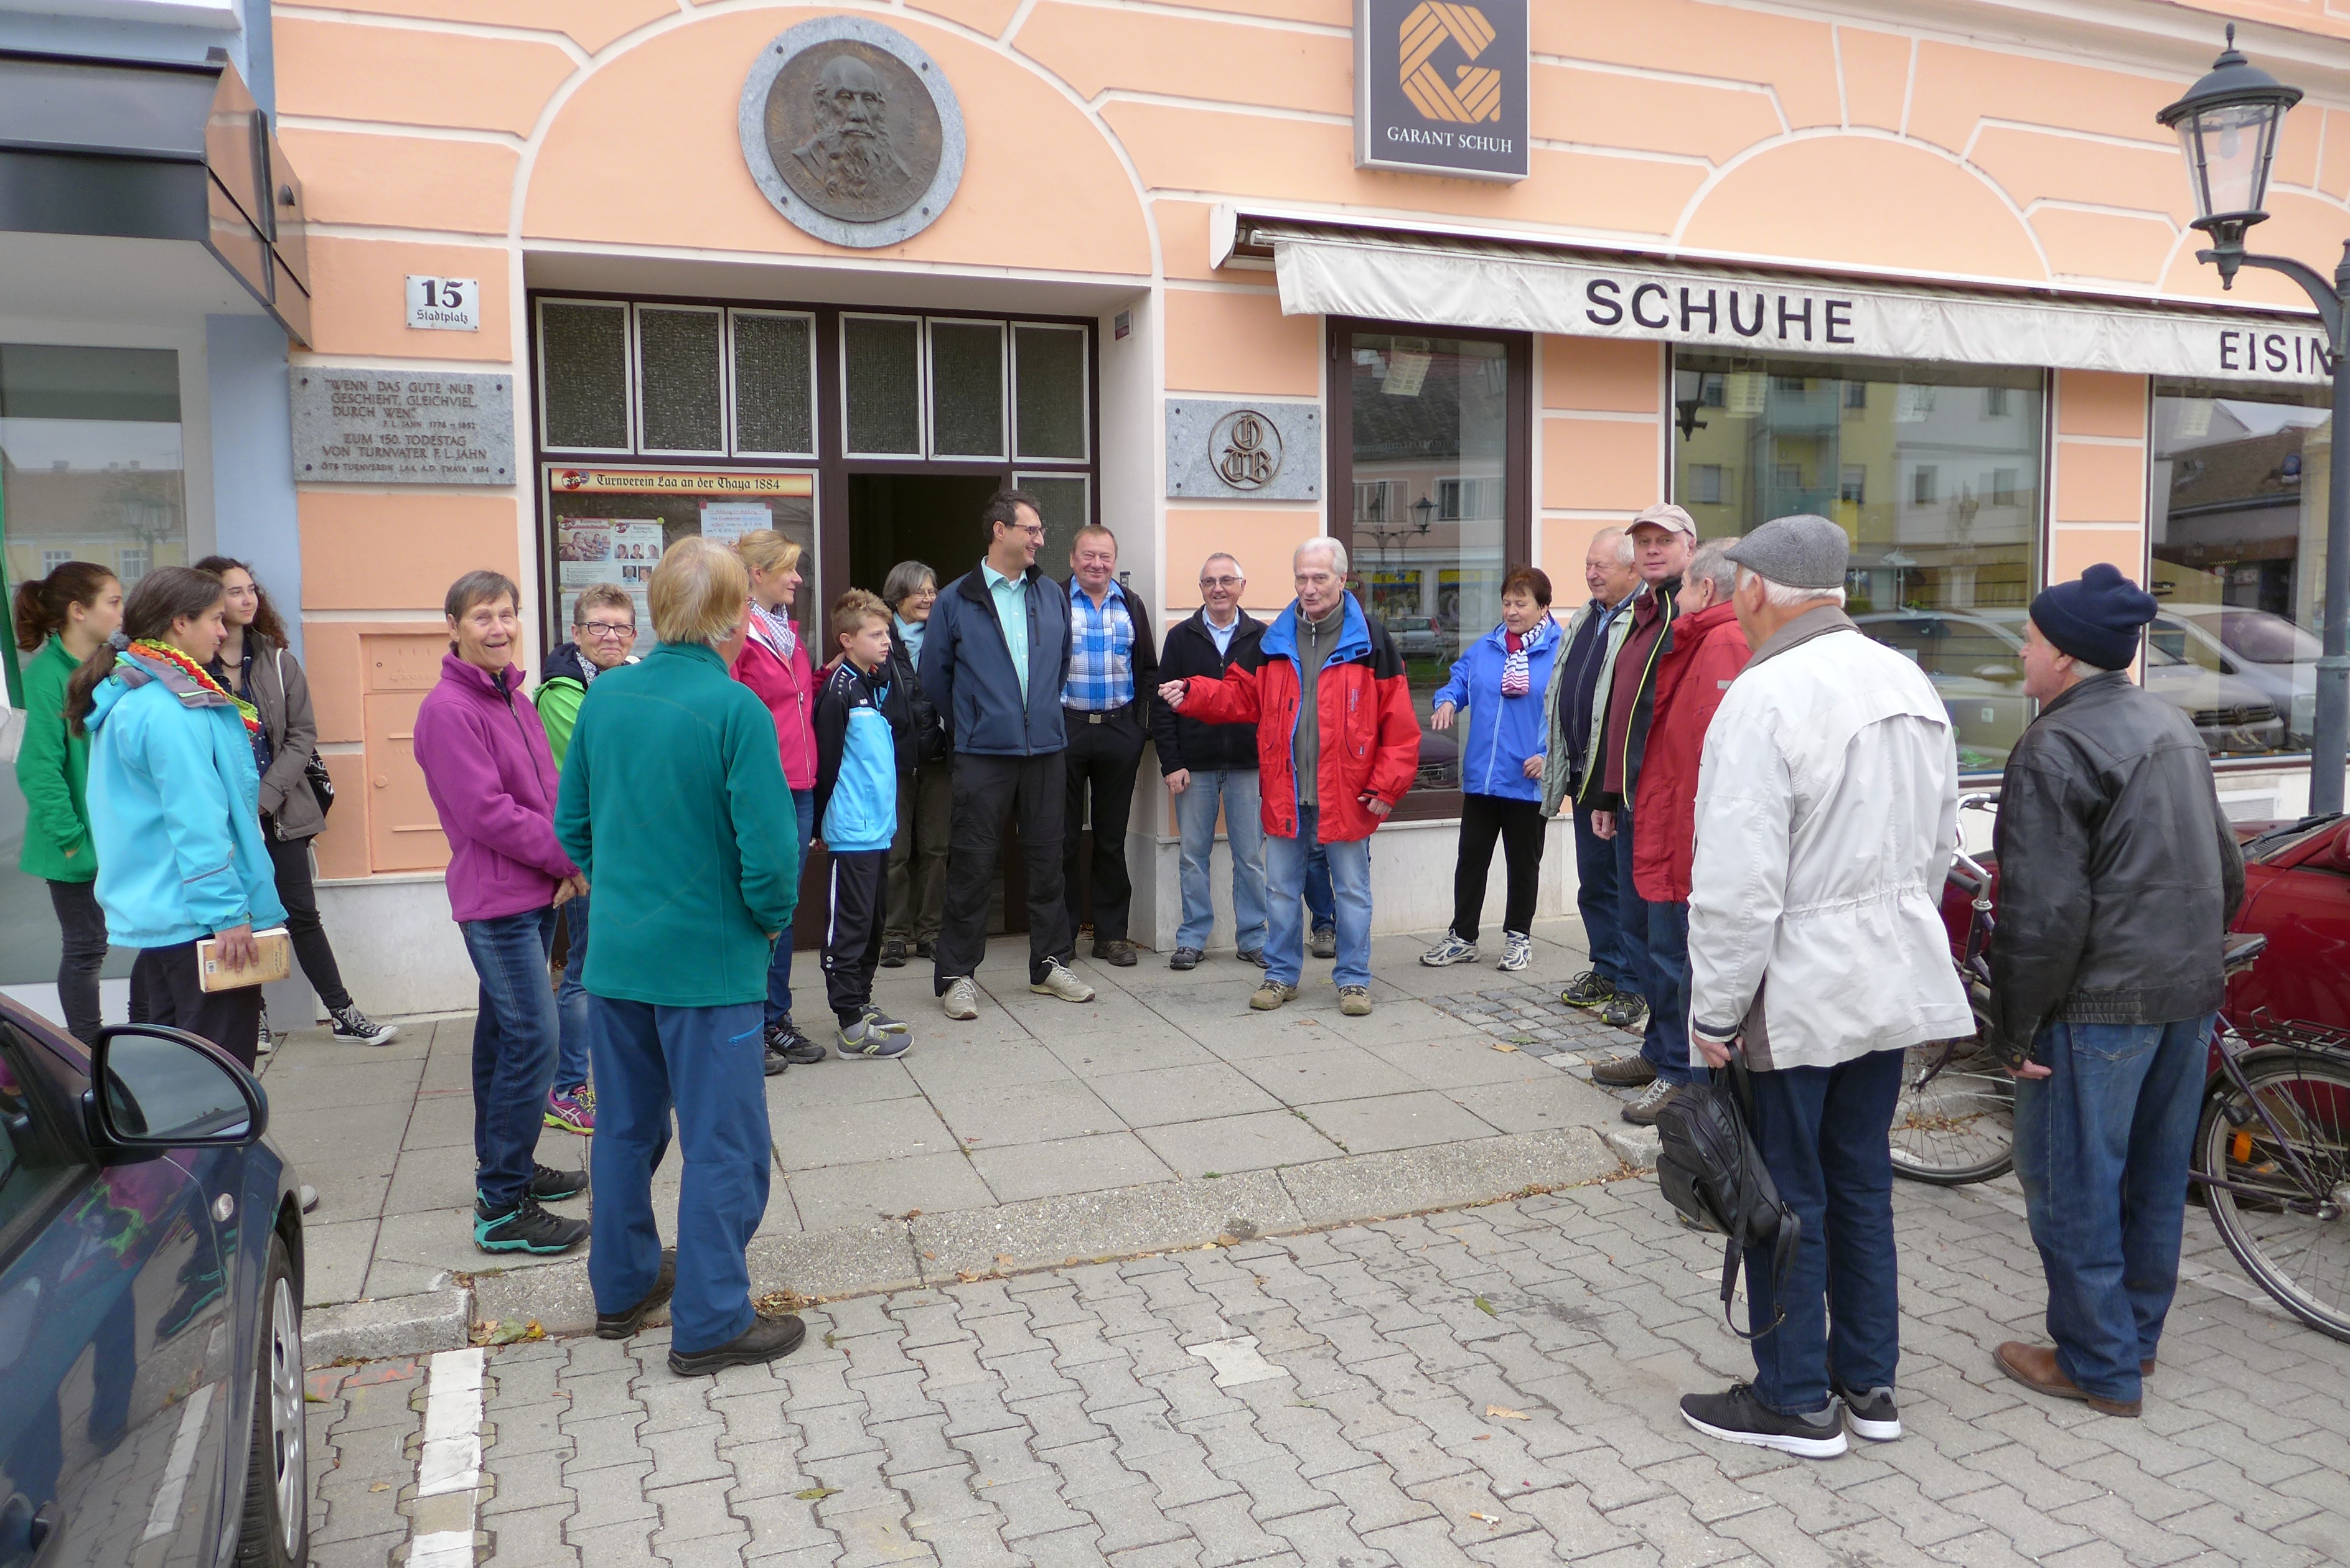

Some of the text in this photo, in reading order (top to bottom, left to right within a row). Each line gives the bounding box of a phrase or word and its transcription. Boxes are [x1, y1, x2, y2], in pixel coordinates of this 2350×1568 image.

[1387, 126, 1513, 154] GARANT SCHUH
[421, 279, 463, 308] 15
[416, 308, 469, 325] Stadtplatz
[1585, 278, 1855, 343] SCHUHE
[377, 380, 401, 392] DAS
[408, 381, 442, 393] GUTE
[449, 383, 474, 394] NUR
[332, 405, 376, 418] DURCH
[343, 433, 467, 447] ZUM 150. TODESTAG
[322, 445, 351, 457] VON
[358, 446, 428, 459] TURNVATER
[456, 449, 487, 460] JAHN
[343, 463, 394, 471] TURNVEREIN
[596, 473, 780, 493] Turnverein Laa an der Thaya 1884
